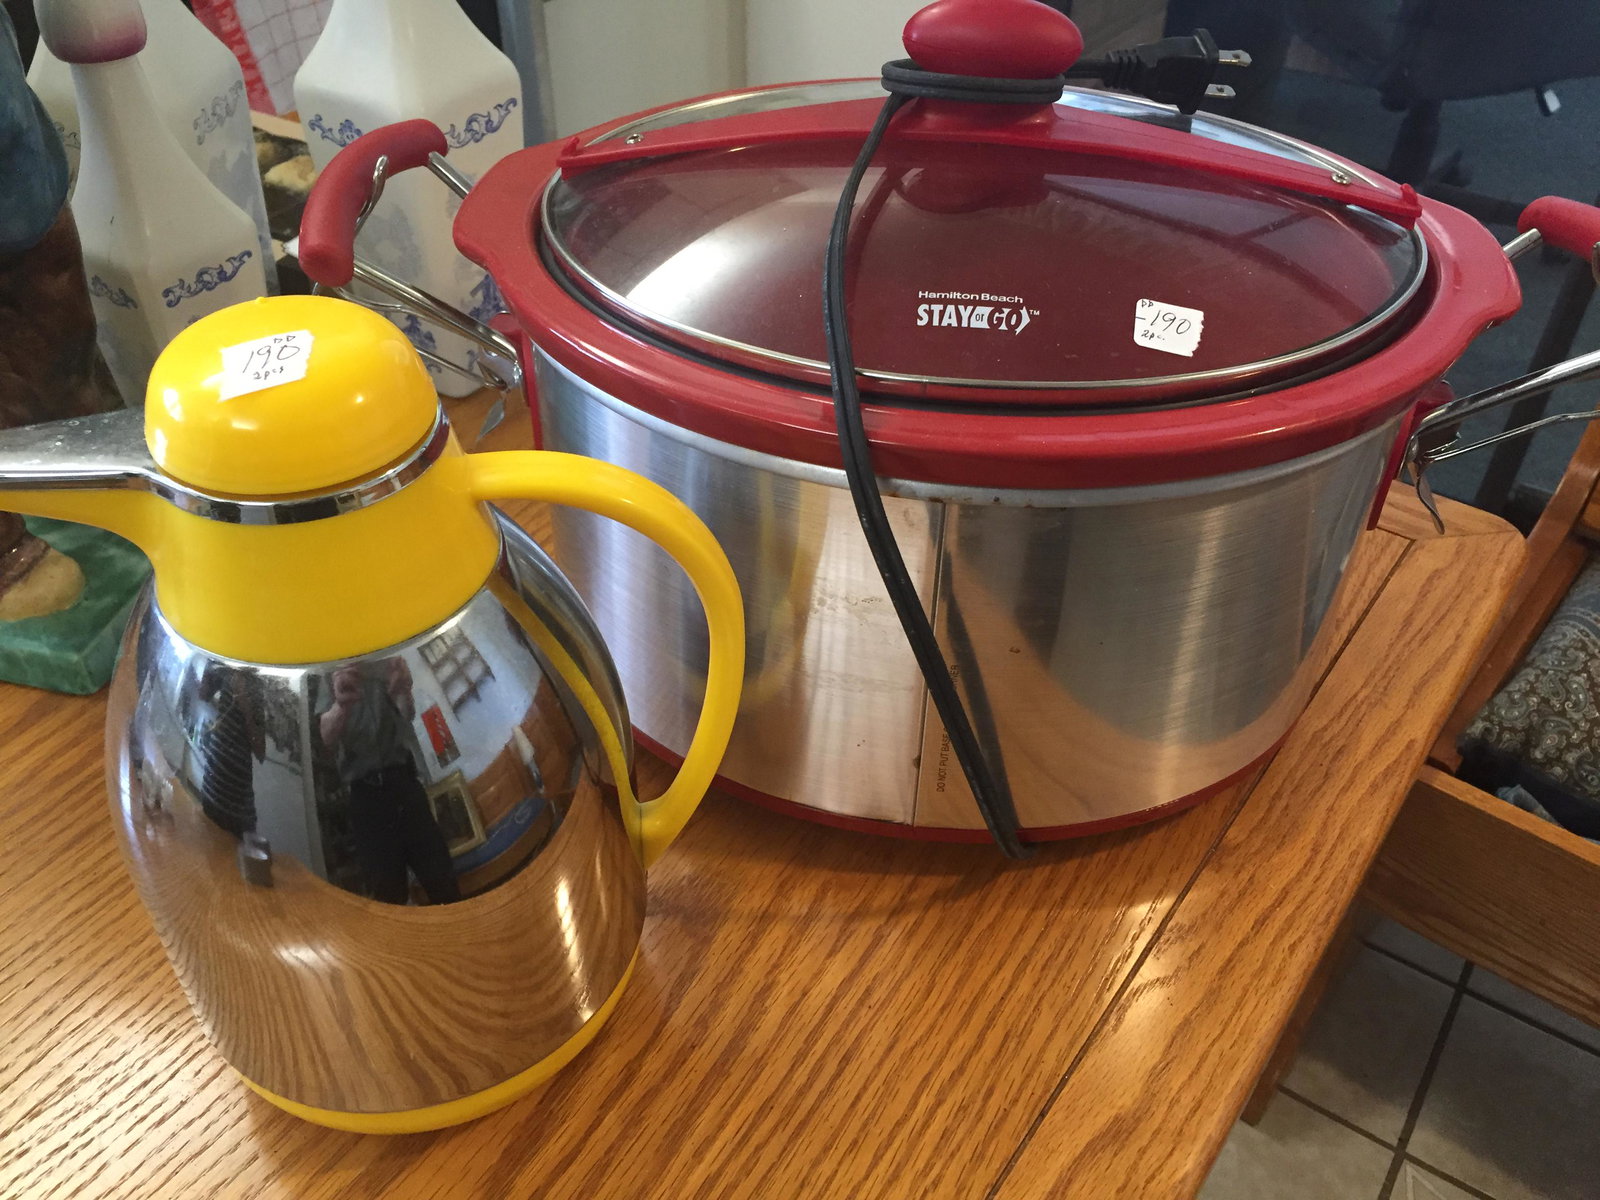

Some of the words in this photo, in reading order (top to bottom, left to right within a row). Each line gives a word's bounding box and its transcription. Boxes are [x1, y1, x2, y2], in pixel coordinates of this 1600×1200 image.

[918, 290, 979, 301] Hamilton
[980, 292, 1024, 304] Beach
[916, 303, 974, 328] STAY
[987, 306, 1025, 332] GO
[242, 345, 301, 374] 190
[939, 752, 949, 767] PUT
[936, 767, 947, 782] NOT
[935, 781, 946, 793] DO
